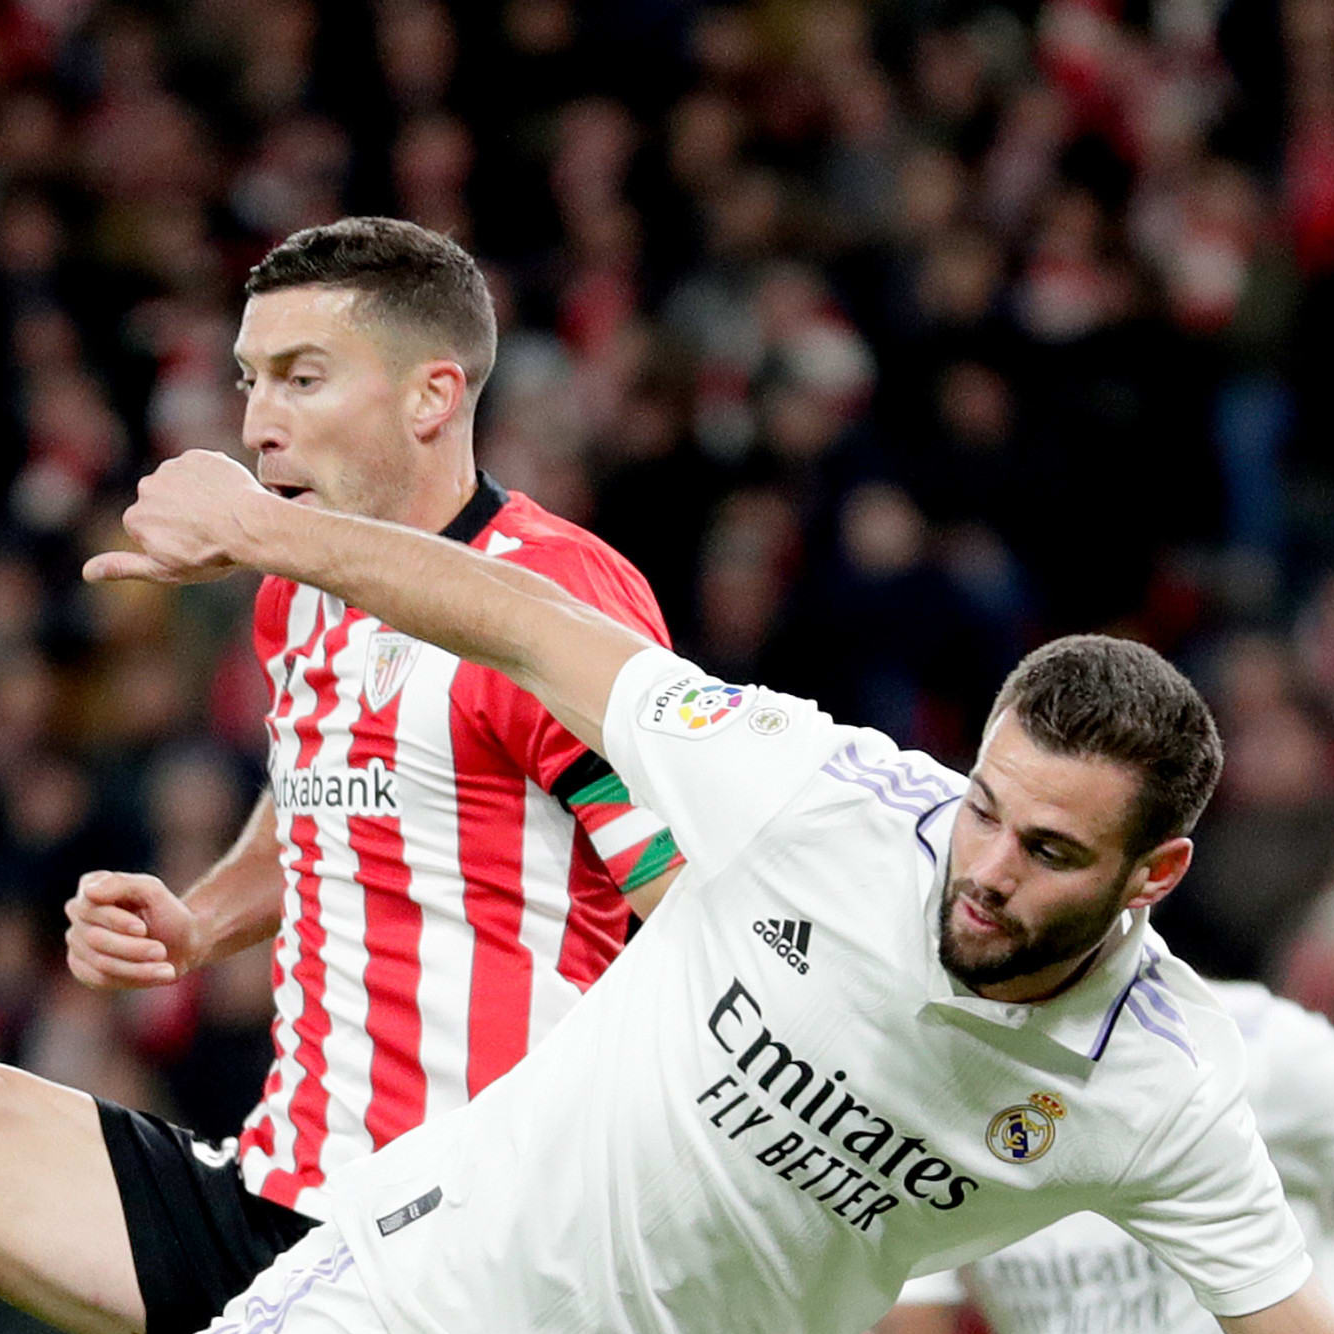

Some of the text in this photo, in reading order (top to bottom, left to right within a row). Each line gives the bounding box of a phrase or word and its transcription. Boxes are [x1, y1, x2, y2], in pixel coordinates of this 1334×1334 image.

[752, 920, 810, 976] adidas
[696, 1074, 900, 1232] FLY BETTER
[708, 976, 979, 1211] Emirates
